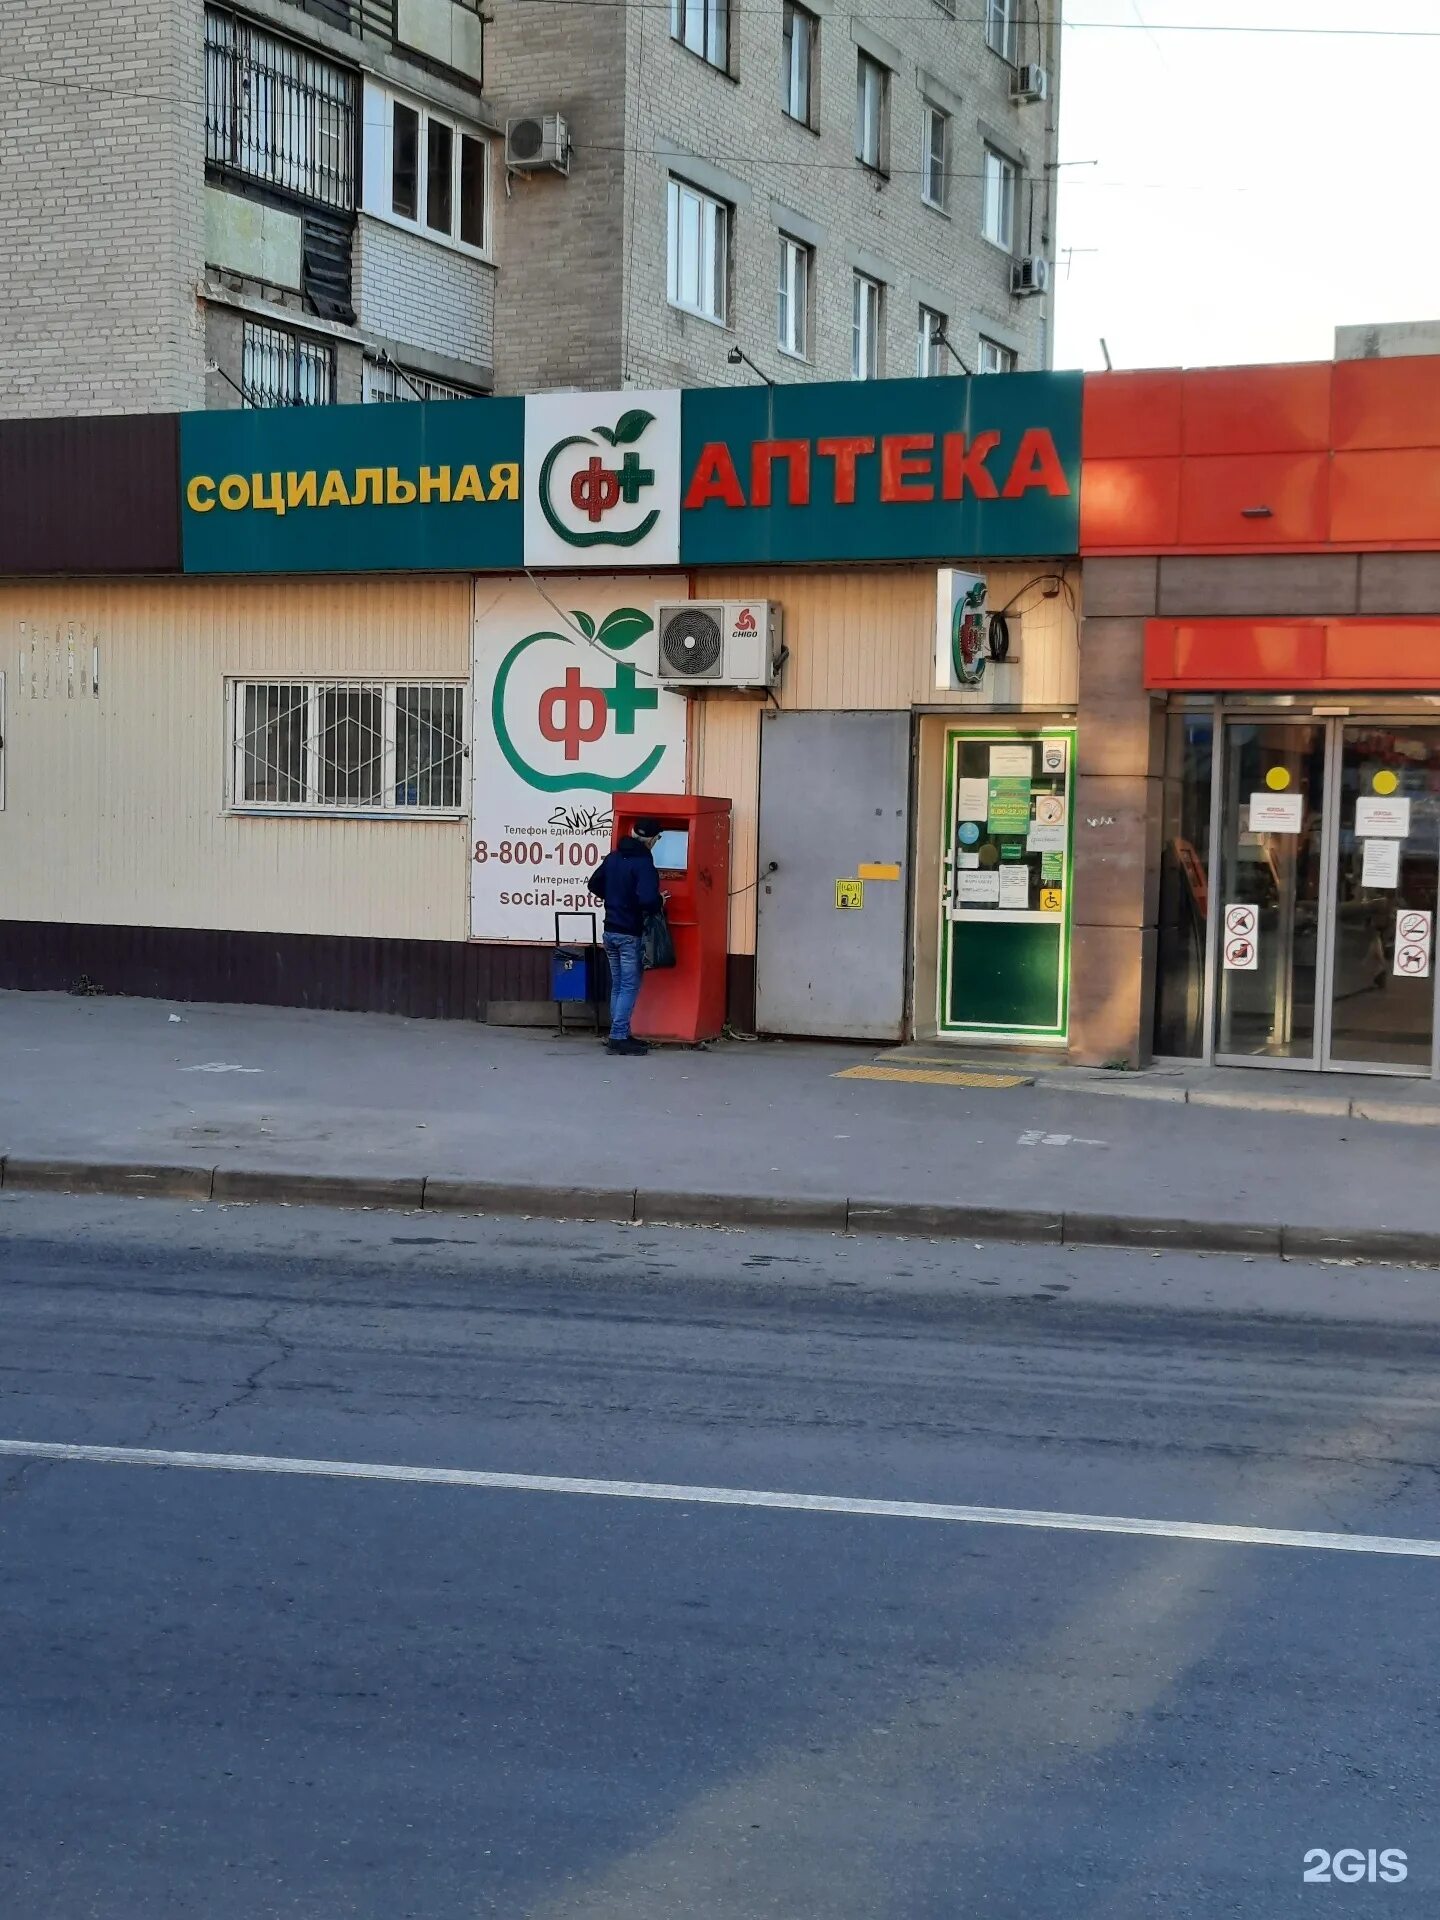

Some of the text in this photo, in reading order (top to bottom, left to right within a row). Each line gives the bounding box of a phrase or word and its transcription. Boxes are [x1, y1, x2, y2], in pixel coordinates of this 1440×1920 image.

[683, 427, 1072, 509] АПТЕКА
[186, 463, 520, 516] СОЦИАЛЬНАЯ
[731, 630, 758, 638] CHIGO
[503, 824, 548, 837] Телефон
